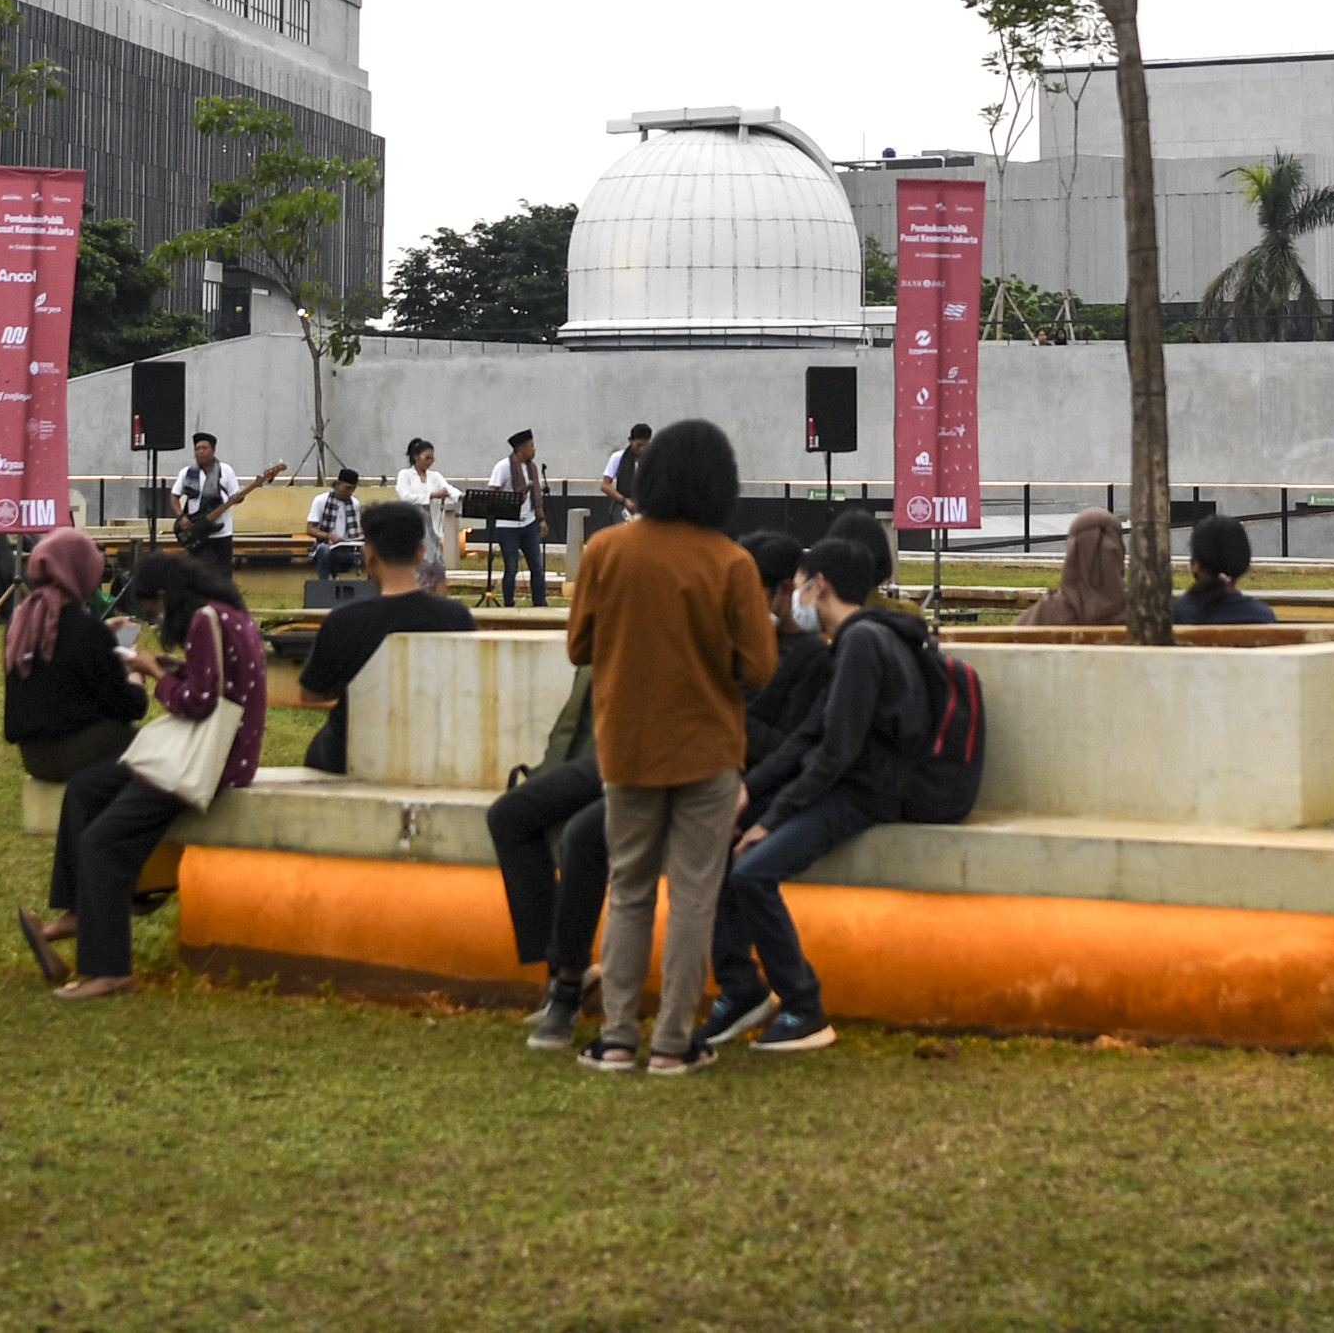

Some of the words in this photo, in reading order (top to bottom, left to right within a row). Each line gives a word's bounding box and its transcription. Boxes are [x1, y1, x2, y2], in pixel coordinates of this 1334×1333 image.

[46, 226, 74, 236] Jakarta
[951, 235, 978, 244] Jakarta
[19, 499, 56, 527] TIM
[932, 497, 968, 523] TIM
